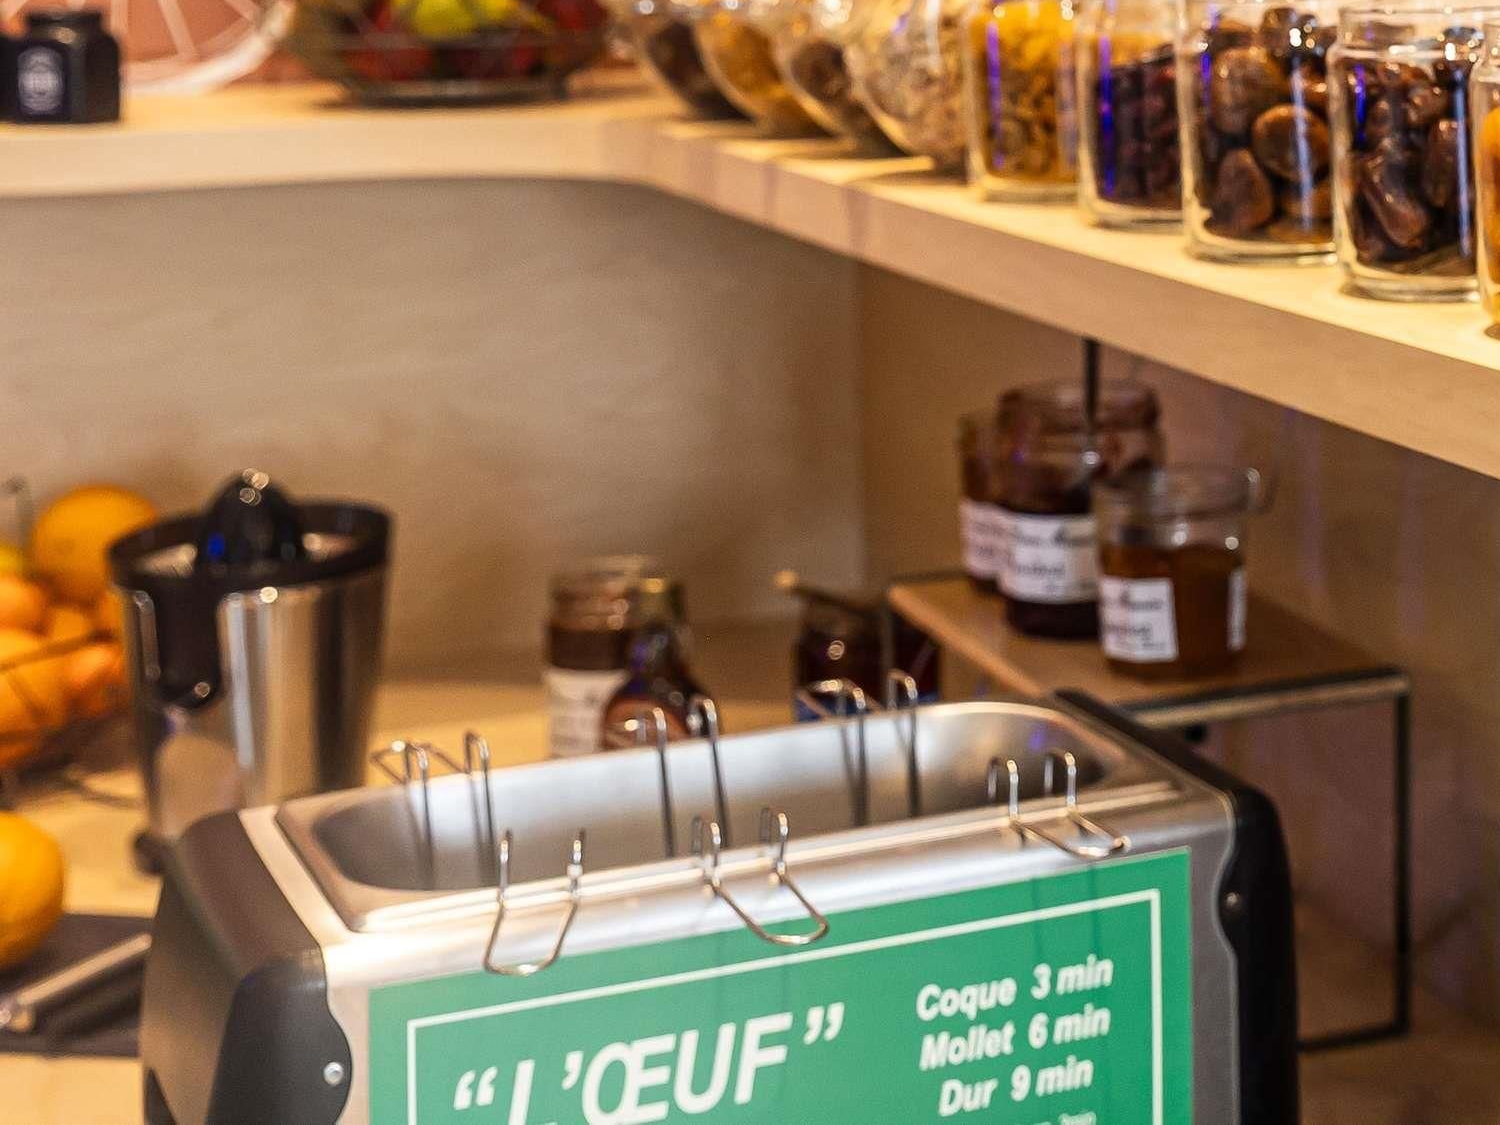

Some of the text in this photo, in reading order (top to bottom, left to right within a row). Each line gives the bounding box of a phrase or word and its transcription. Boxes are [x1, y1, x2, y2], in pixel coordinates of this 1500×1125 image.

[916, 954, 1114, 1021] Coque 3 min
[919, 1003, 1112, 1071] Mollet 6 min
[938, 1054, 1094, 1117] Dur 9 min
